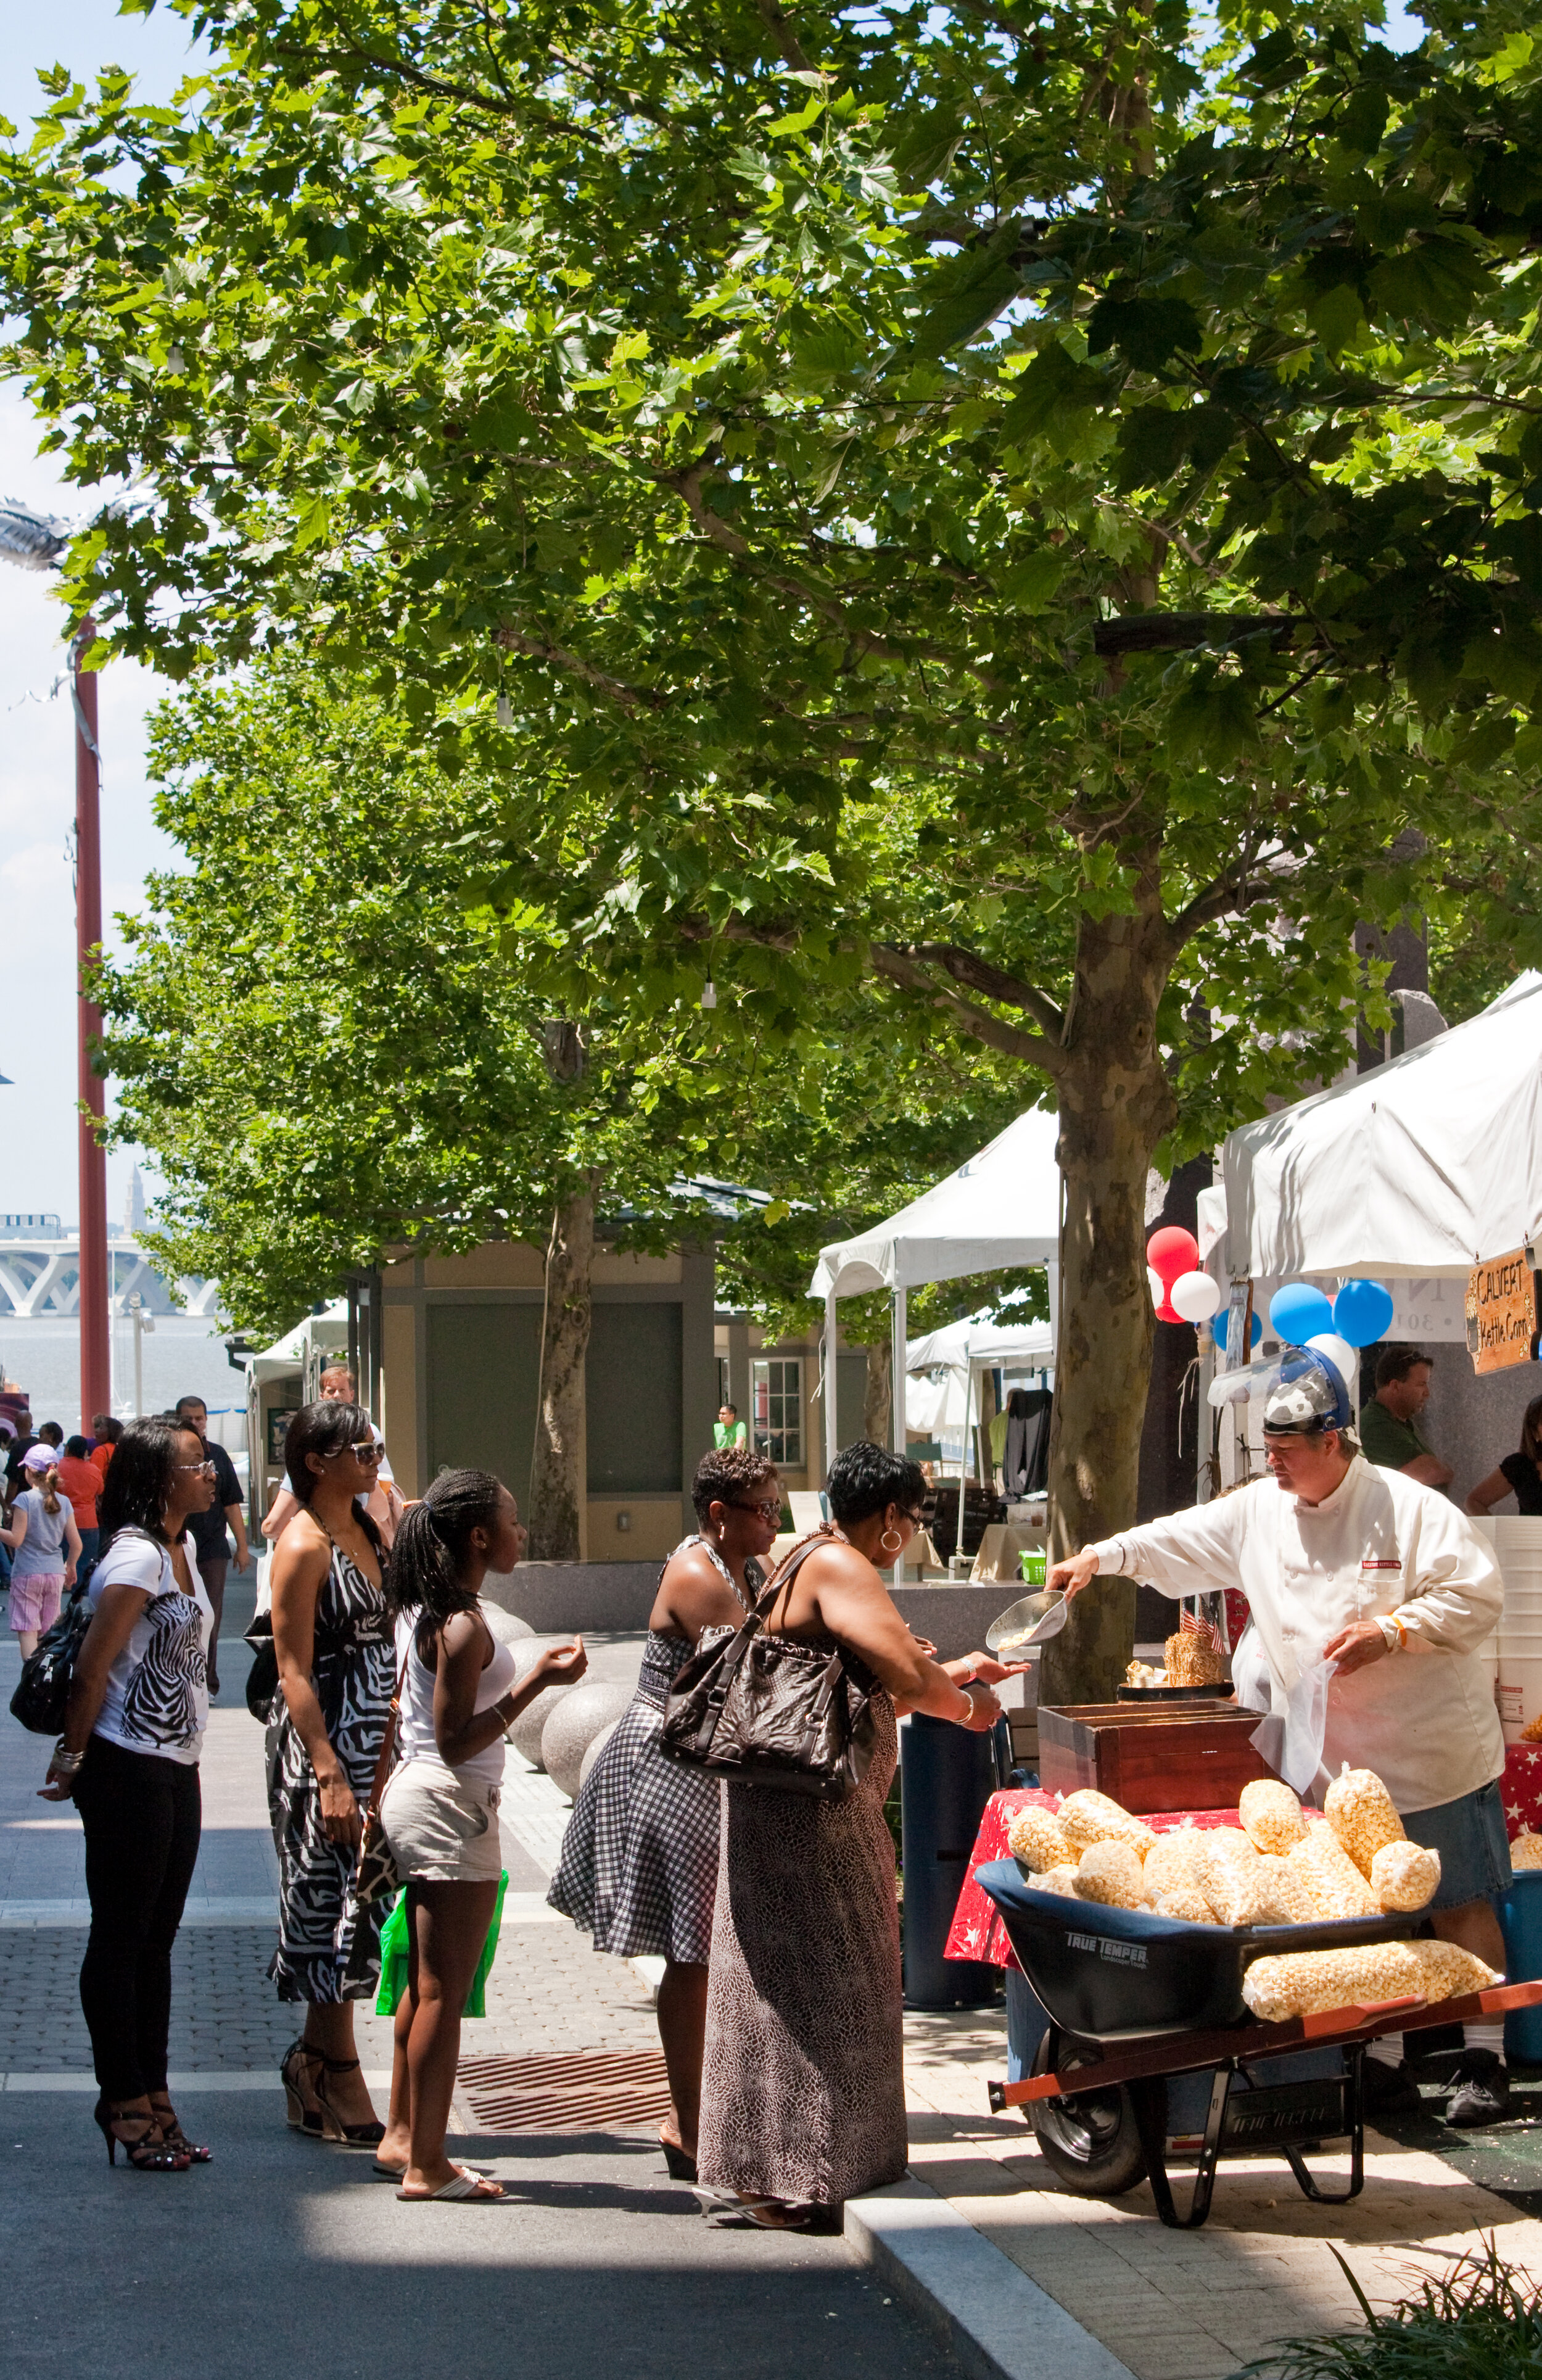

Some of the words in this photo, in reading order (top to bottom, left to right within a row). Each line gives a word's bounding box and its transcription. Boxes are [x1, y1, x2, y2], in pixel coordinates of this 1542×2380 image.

[1477, 1259, 1523, 1304] CALVERT
[1480, 1316, 1505, 1348] Kettle
[1506, 1312, 1527, 1340] Corn
[1065, 1931, 1097, 1952] TRUE
[1098, 1936, 1147, 1962] TEMPER
